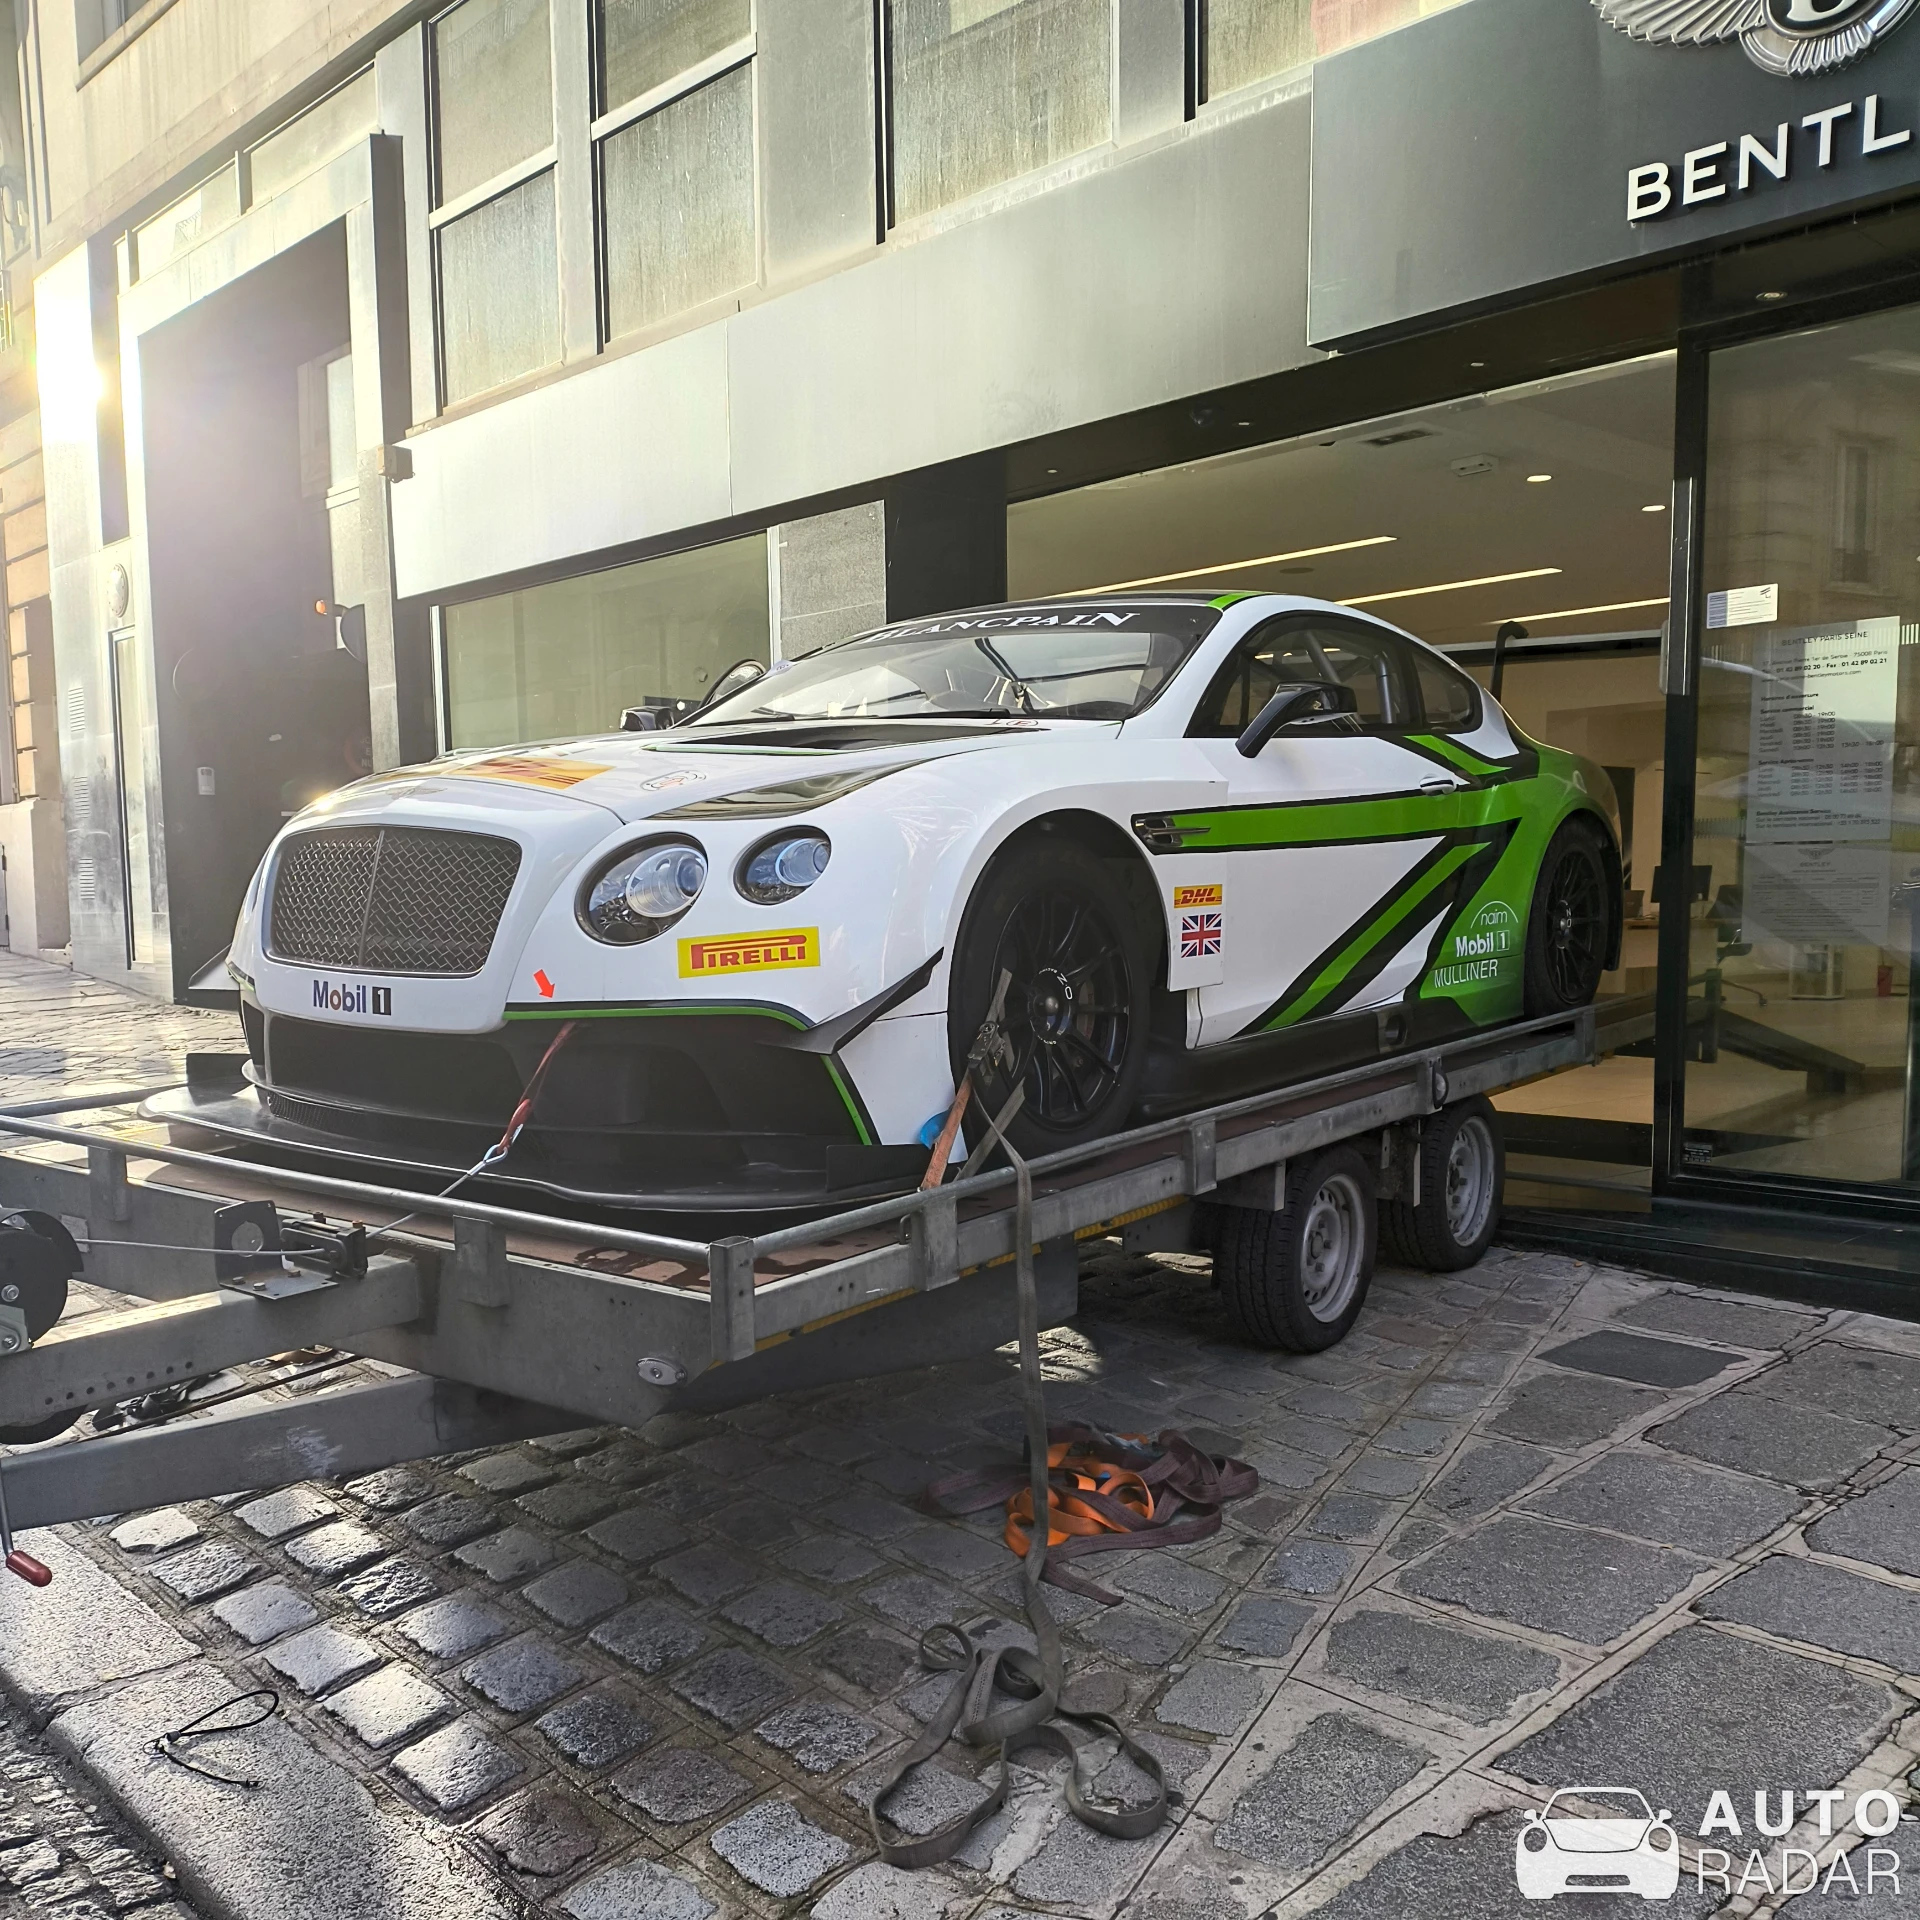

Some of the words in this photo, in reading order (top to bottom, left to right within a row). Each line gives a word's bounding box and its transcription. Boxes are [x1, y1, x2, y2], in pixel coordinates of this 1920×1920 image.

[1627, 94, 1911, 221] BENTL
[859, 612, 1141, 644] BLANCPAIN
[1782, 636, 1817, 646] BENTLEY
[1845, 631, 1868, 640] SEINE
[1180, 888, 1216, 904] DHL
[1480, 909, 1508, 926] naim
[690, 934, 807, 970] PIRELLI
[1456, 932, 1494, 958] Mobil
[1434, 959, 1498, 988] MULLINER
[313, 980, 366, 1013] Mobil
